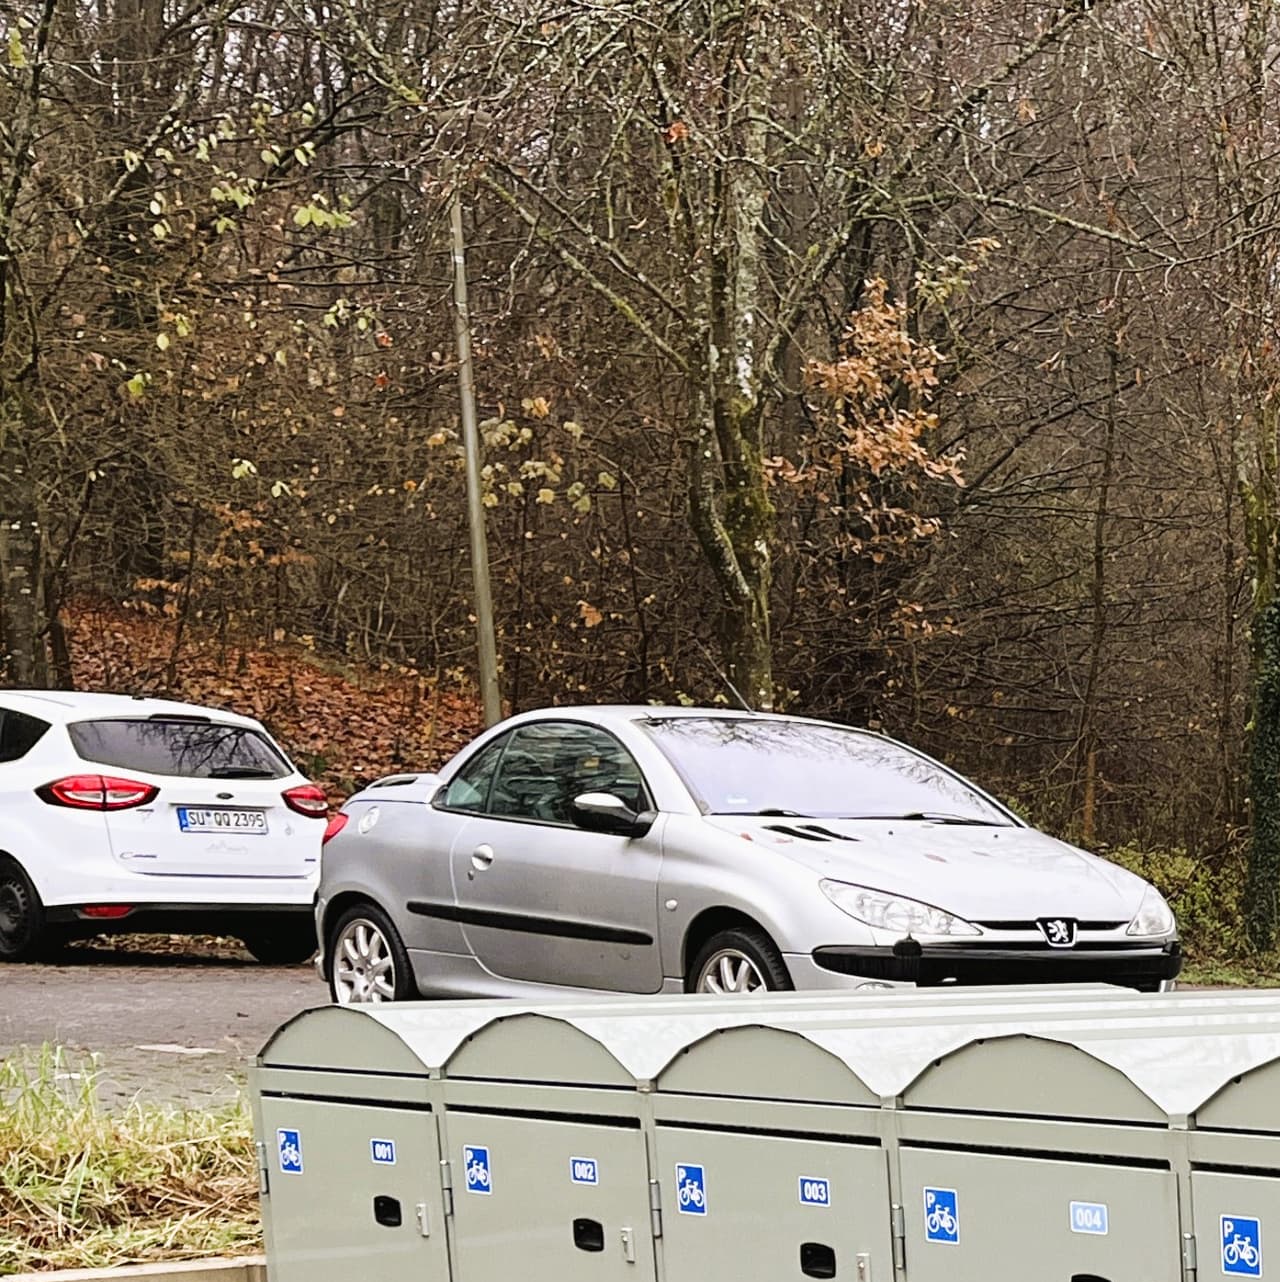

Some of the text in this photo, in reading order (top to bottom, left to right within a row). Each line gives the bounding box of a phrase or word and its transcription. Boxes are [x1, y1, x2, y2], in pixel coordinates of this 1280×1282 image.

[188, 811, 205, 826] SU
[233, 813, 265, 828] 2395
[374, 1143, 393, 1161] 001
[574, 1161, 594, 1180] 002
[804, 1181, 826, 1201] 003
[926, 1192, 936, 1208] P
[1075, 1208, 1102, 1229] 004
[1223, 1220, 1234, 1238] P
